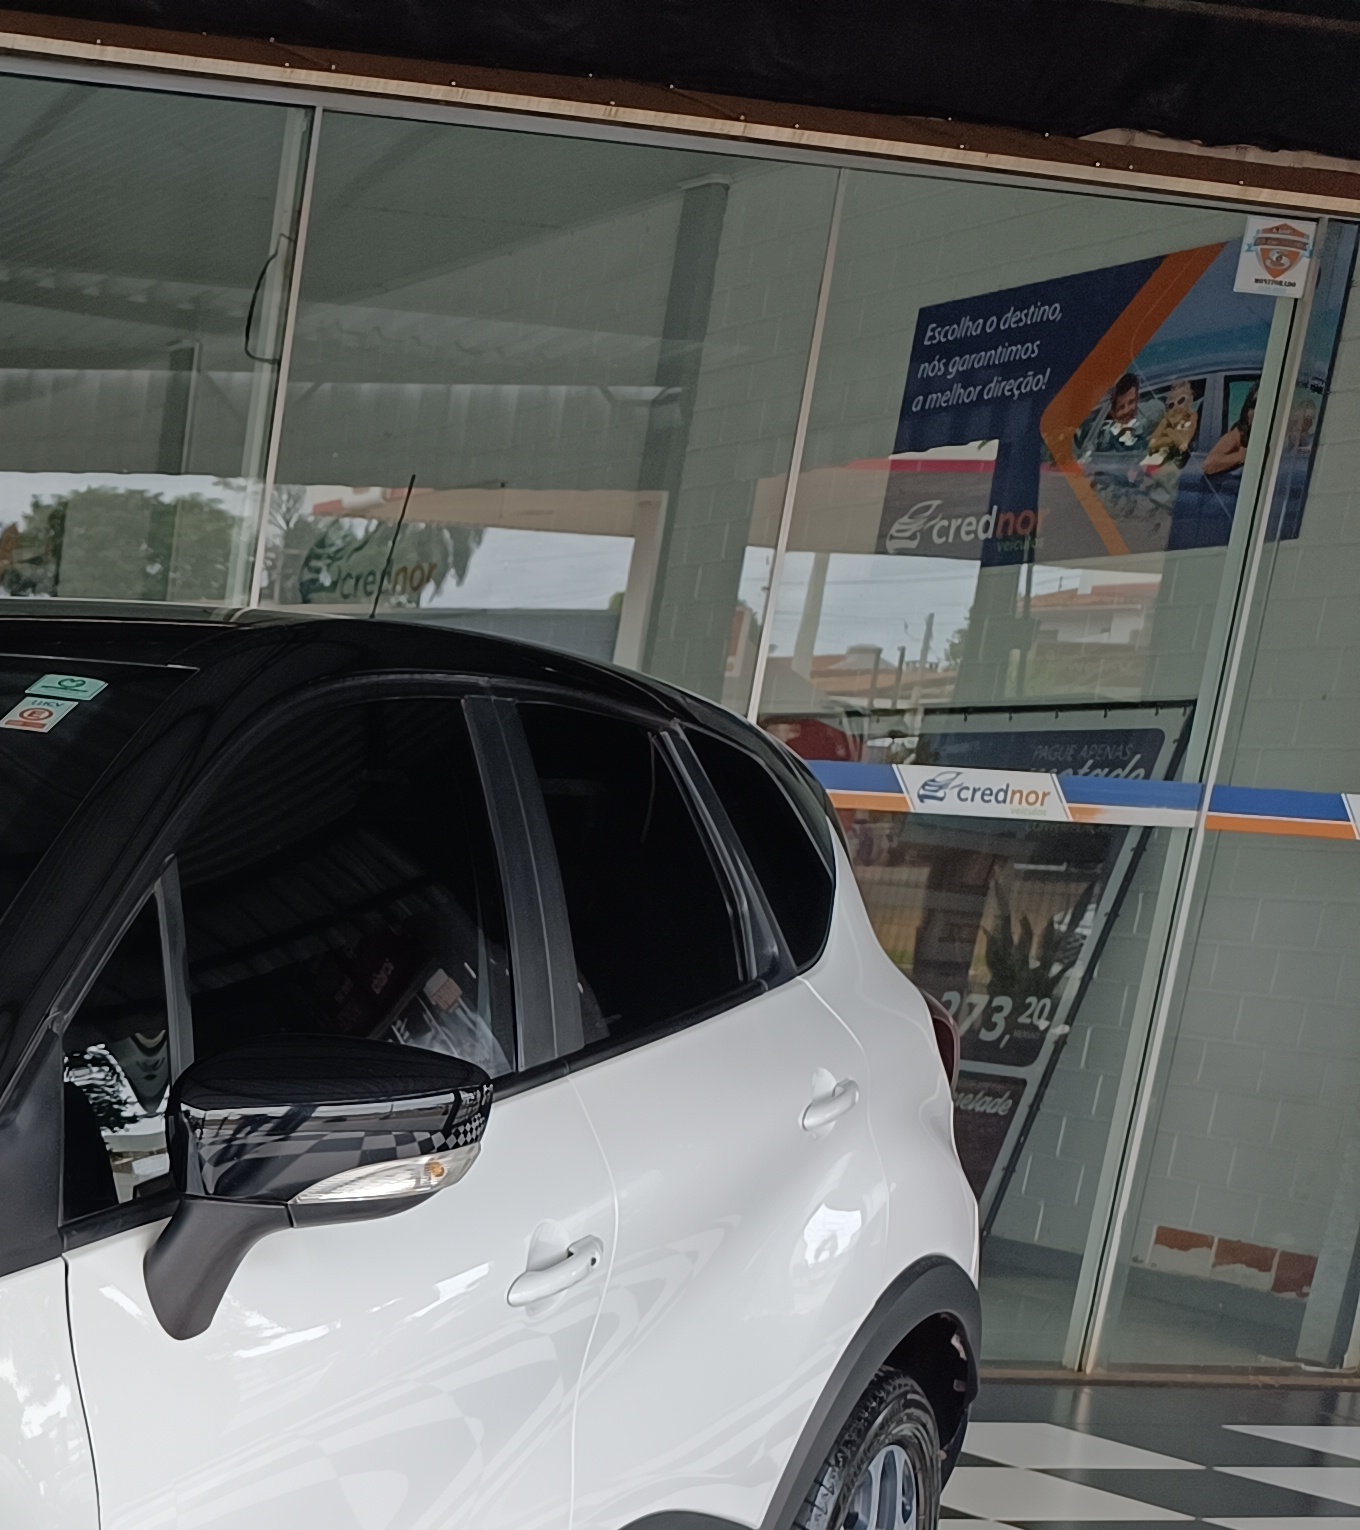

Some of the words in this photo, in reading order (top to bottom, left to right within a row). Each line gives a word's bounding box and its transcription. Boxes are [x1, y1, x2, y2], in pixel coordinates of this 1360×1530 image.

[924, 310, 983, 346] Escolha
[985, 316, 997, 332] o
[1000, 299, 1064, 330] destino,
[918, 352, 945, 379] nós
[948, 339, 1040, 380] garantimos
[911, 397, 922, 412] a
[924, 384, 981, 410] melhor
[983, 367, 1051, 402] direção!
[932, 505, 1051, 545] crednor
[957, 783, 1051, 807] crednor
